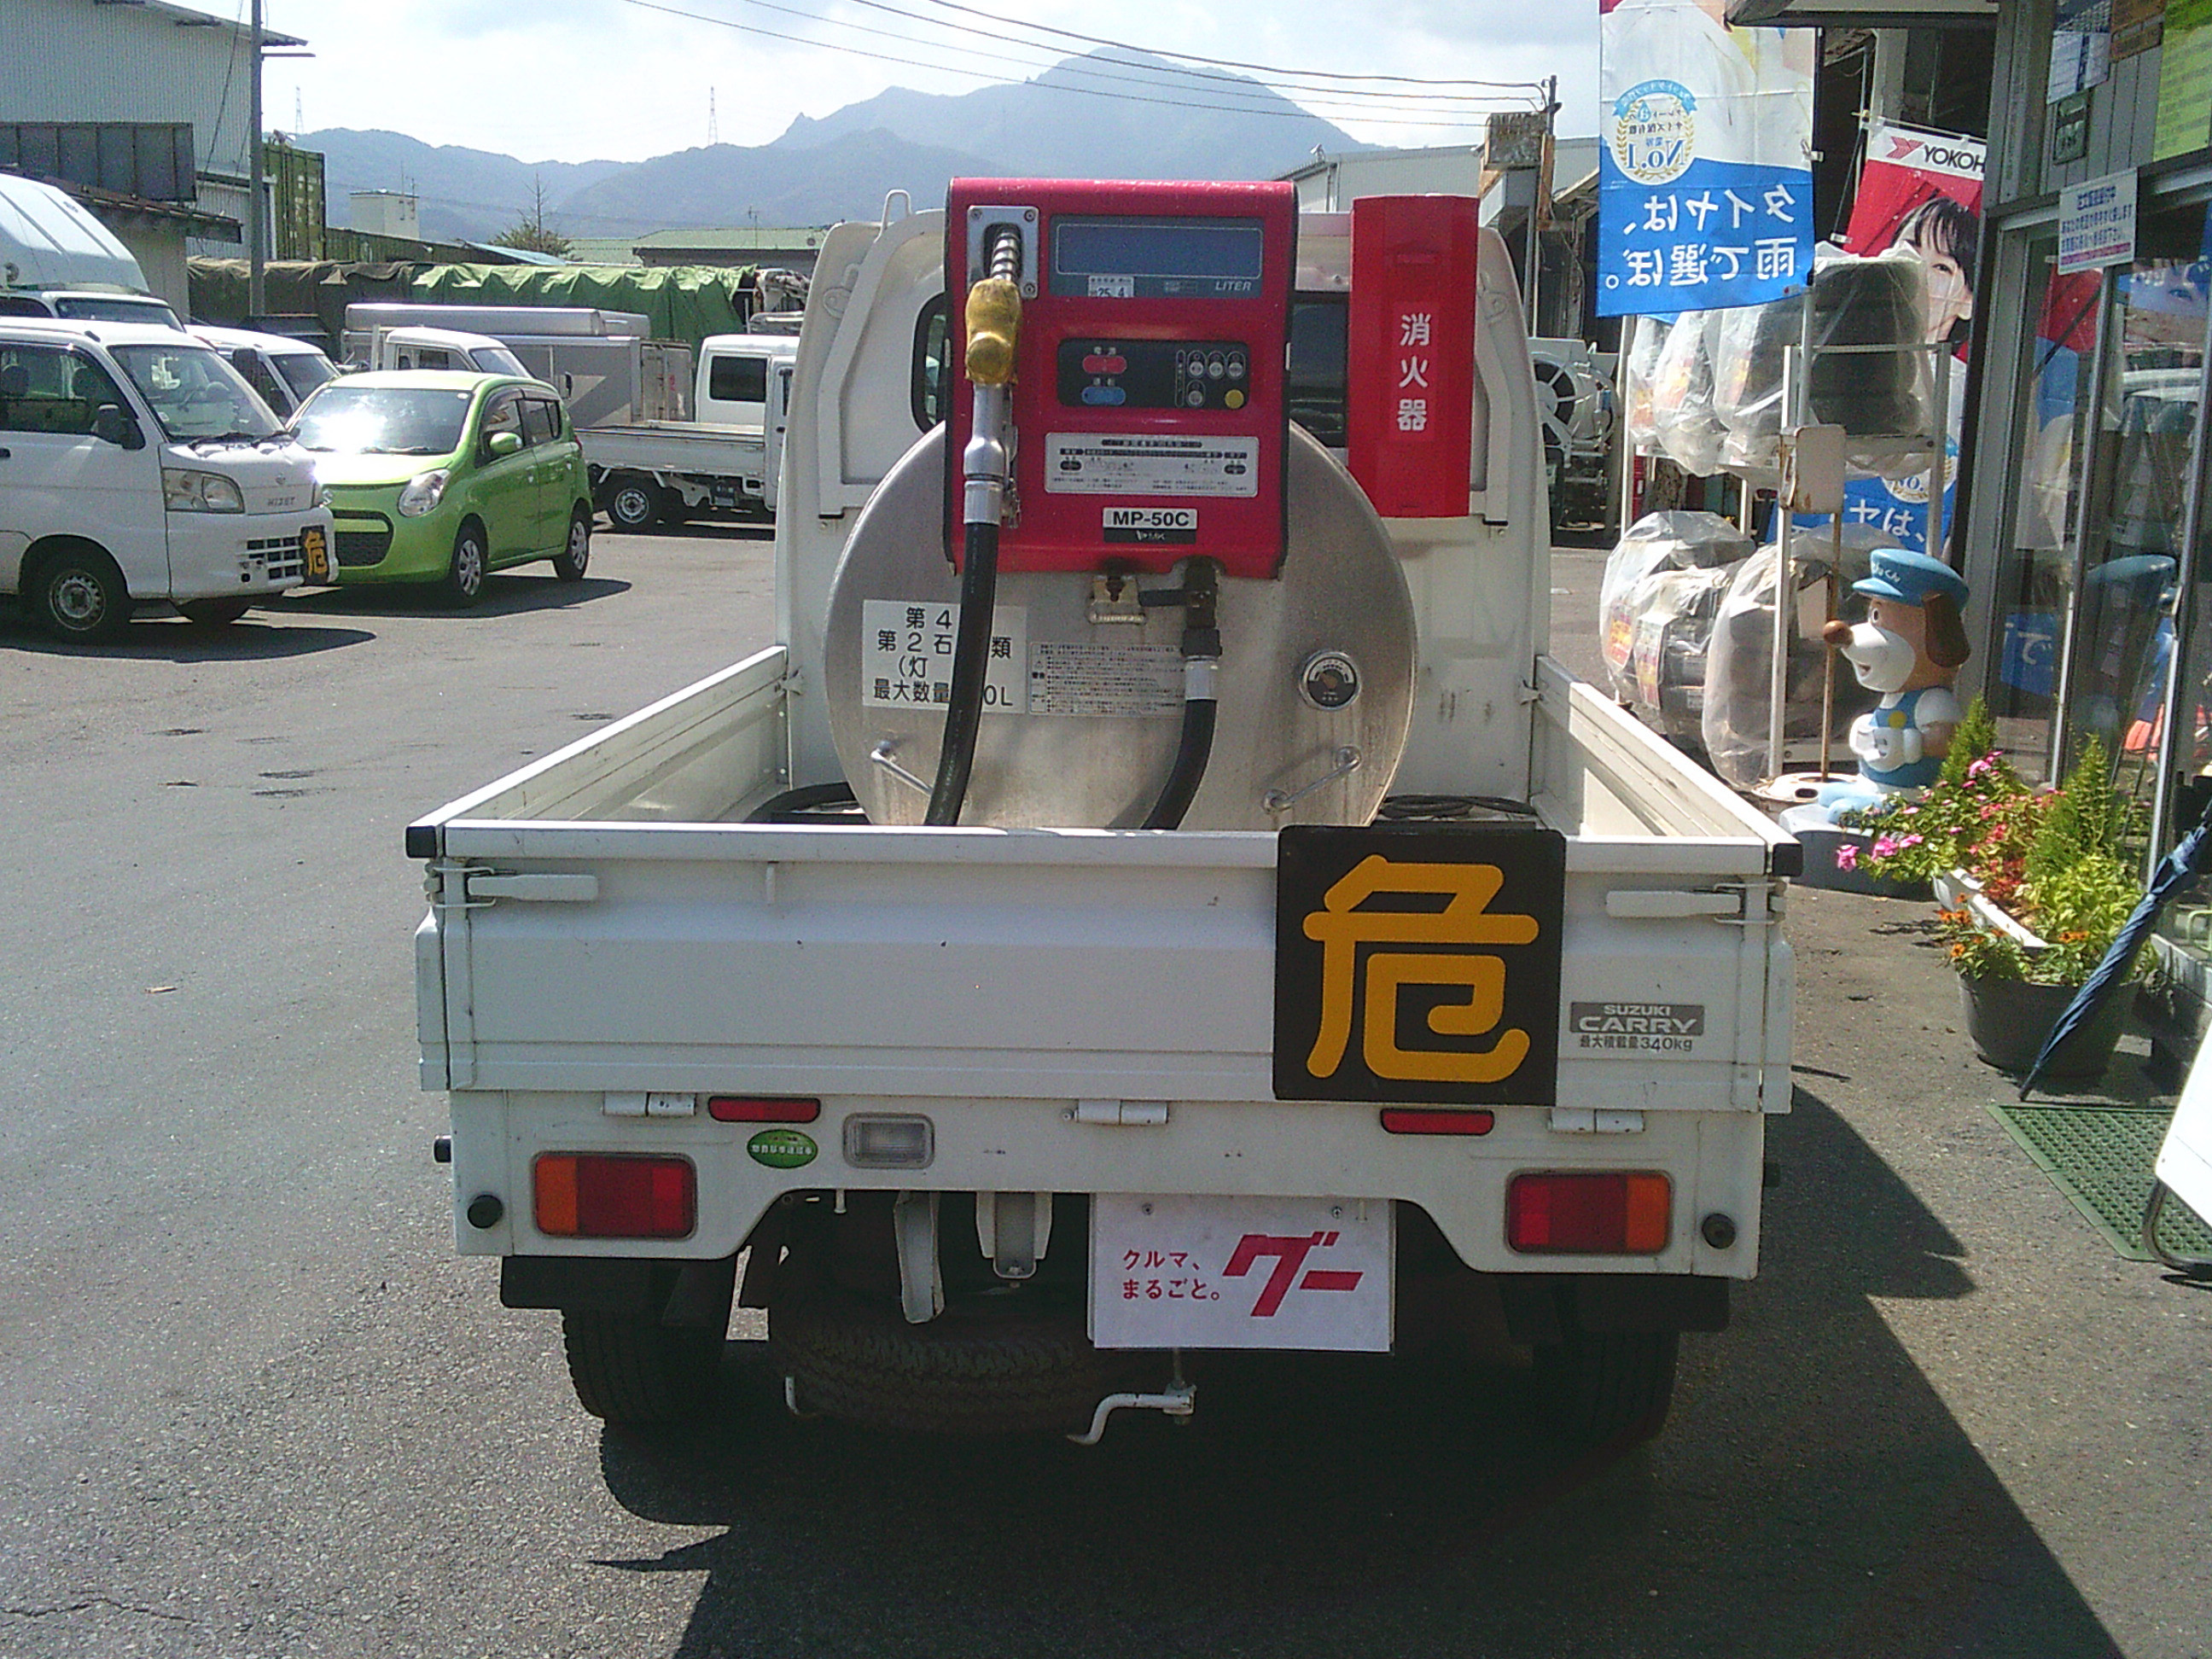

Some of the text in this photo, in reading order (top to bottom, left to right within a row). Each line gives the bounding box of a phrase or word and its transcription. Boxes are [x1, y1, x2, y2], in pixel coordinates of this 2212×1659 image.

[1214, 281, 1252, 292] LITER
[1397, 312, 1431, 431] 消火器
[1113, 511, 1190, 527] MP-50C
[305, 531, 328, 577] 危
[906, 607, 952, 629] 第4
[877, 629, 1011, 659] 第2石類
[899, 655, 928, 678] (灯
[1302, 854, 1540, 1083] 危
[1604, 1004, 1671, 1016] SUZUKI
[1579, 1016, 1697, 1033] CARRY
[1122, 1249, 1201, 1271] クルマ、
[1222, 1231, 1364, 1317] グー
[1122, 1278, 1220, 1301] まるごと。
